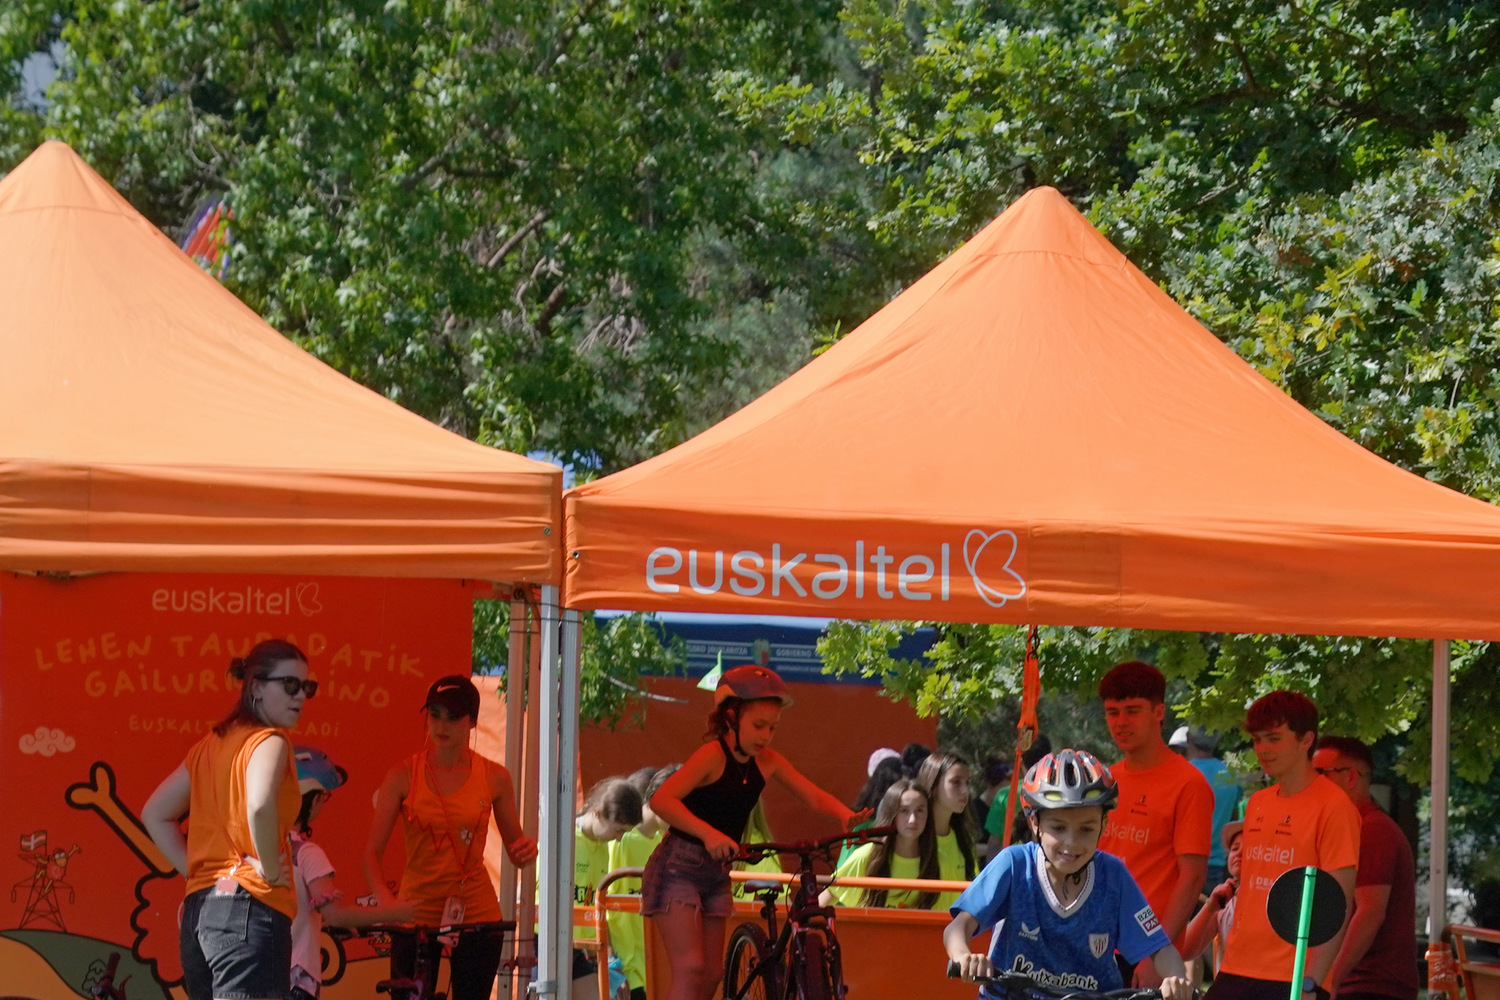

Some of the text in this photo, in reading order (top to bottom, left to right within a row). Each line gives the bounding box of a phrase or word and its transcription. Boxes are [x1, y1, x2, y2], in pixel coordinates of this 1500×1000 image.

[645, 540, 951, 602] euskaltel
[151, 586, 291, 615] euskaltel
[34, 632, 152, 671] LEHEN
[1103, 822, 1150, 845] skaltel
[1246, 844, 1295, 865] uskaltel
[1012, 953, 1099, 991] Kutxabank
